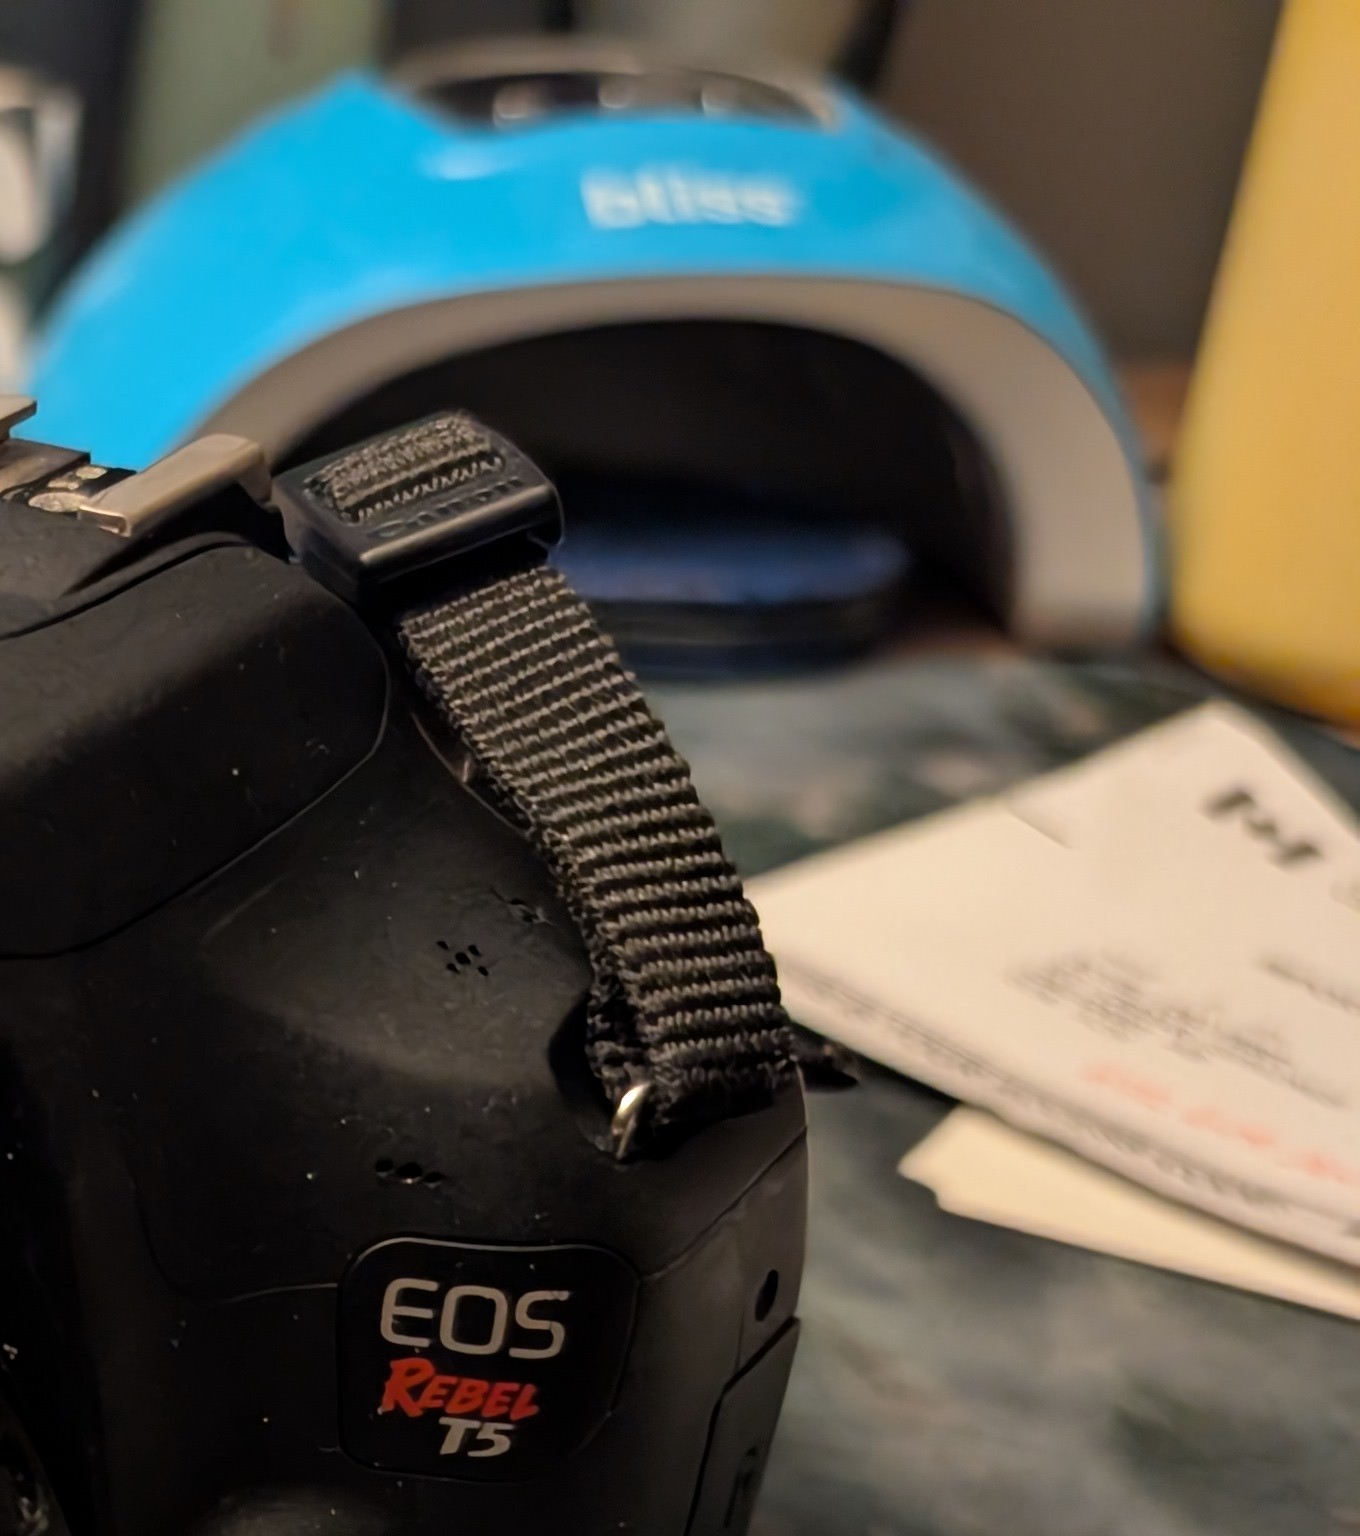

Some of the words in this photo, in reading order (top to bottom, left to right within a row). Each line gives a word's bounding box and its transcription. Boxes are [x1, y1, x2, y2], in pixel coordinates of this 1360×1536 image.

[582, 165, 800, 229] bliss
[380, 1277, 571, 1360] EOS
[438, 1416, 516, 1457] T5
